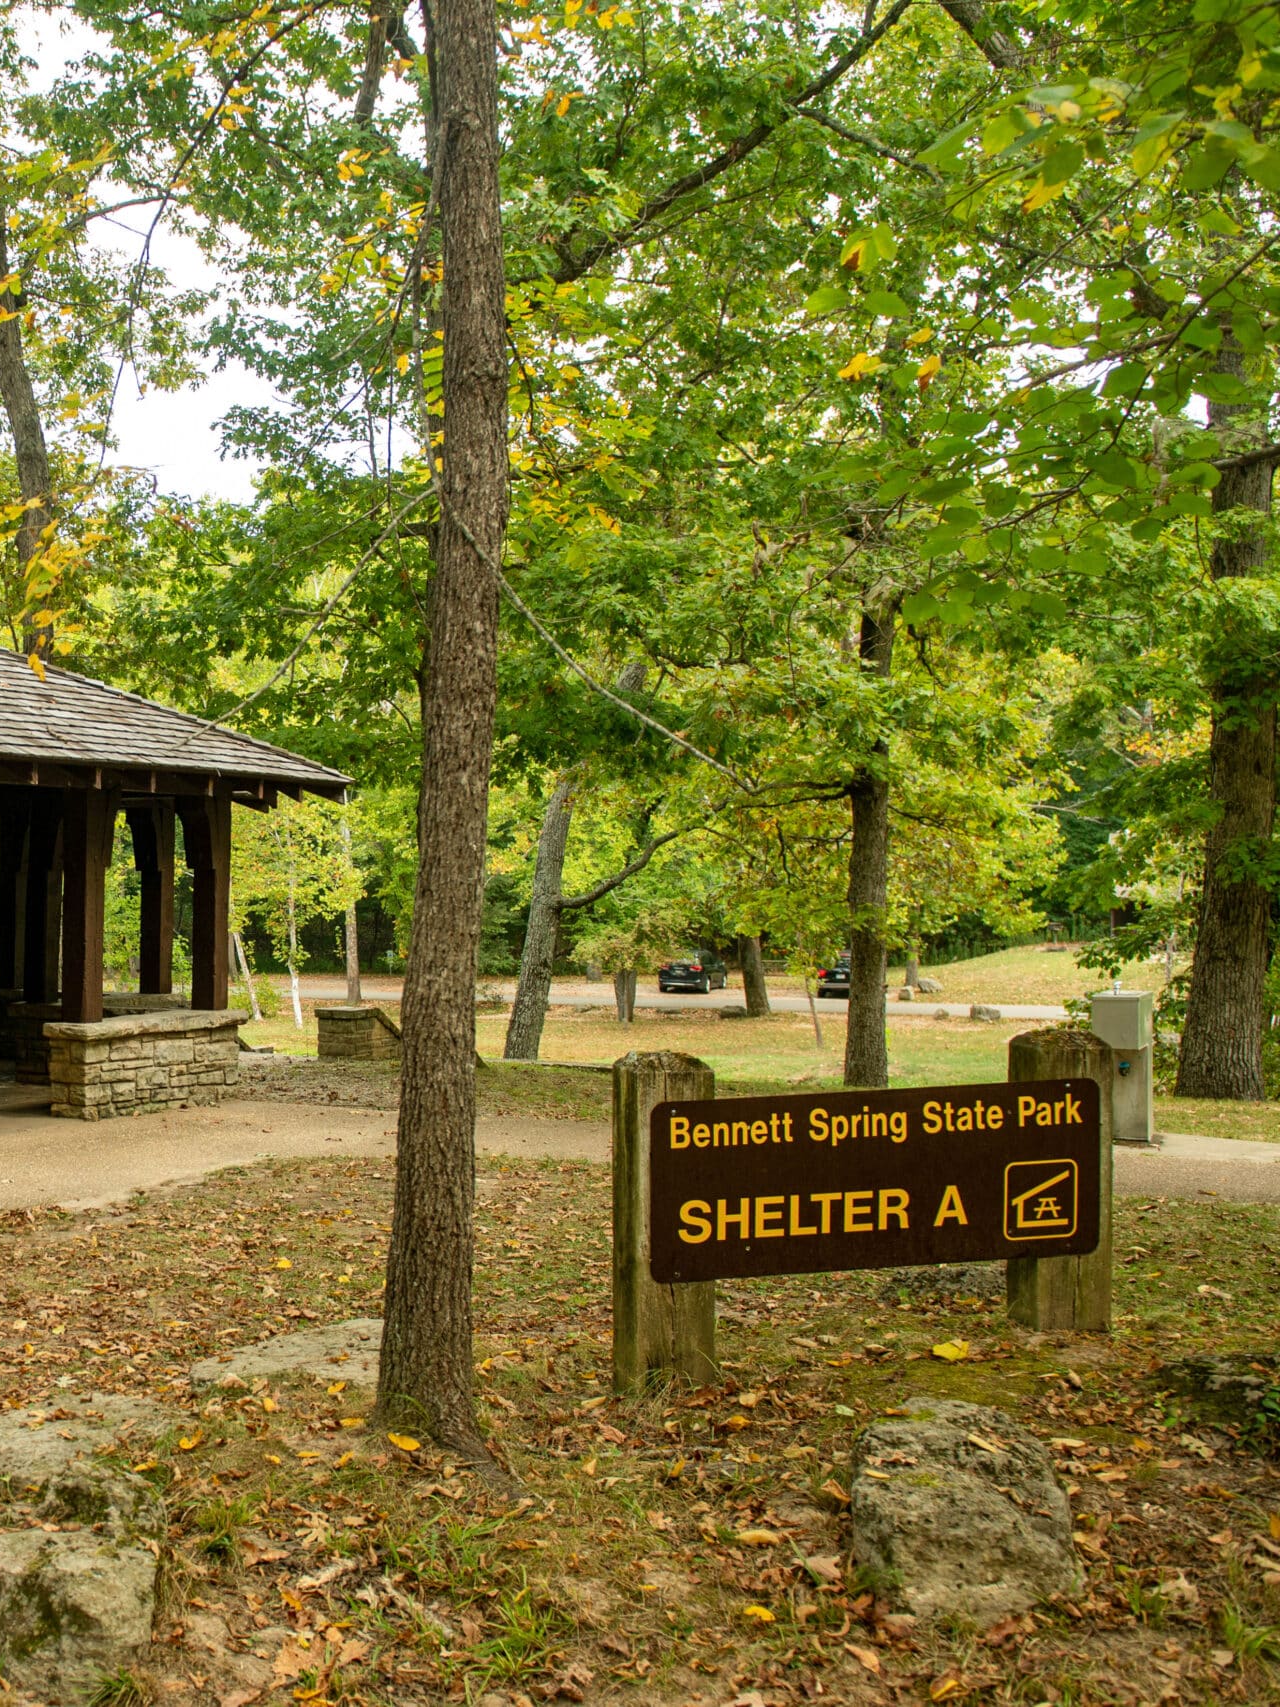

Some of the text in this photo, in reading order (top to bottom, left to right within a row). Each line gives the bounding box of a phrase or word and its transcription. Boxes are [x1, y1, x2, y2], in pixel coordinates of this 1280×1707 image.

[670, 1094, 1082, 1149] Bennett Spring State Park
[678, 1185, 968, 1243] SHELTER A
